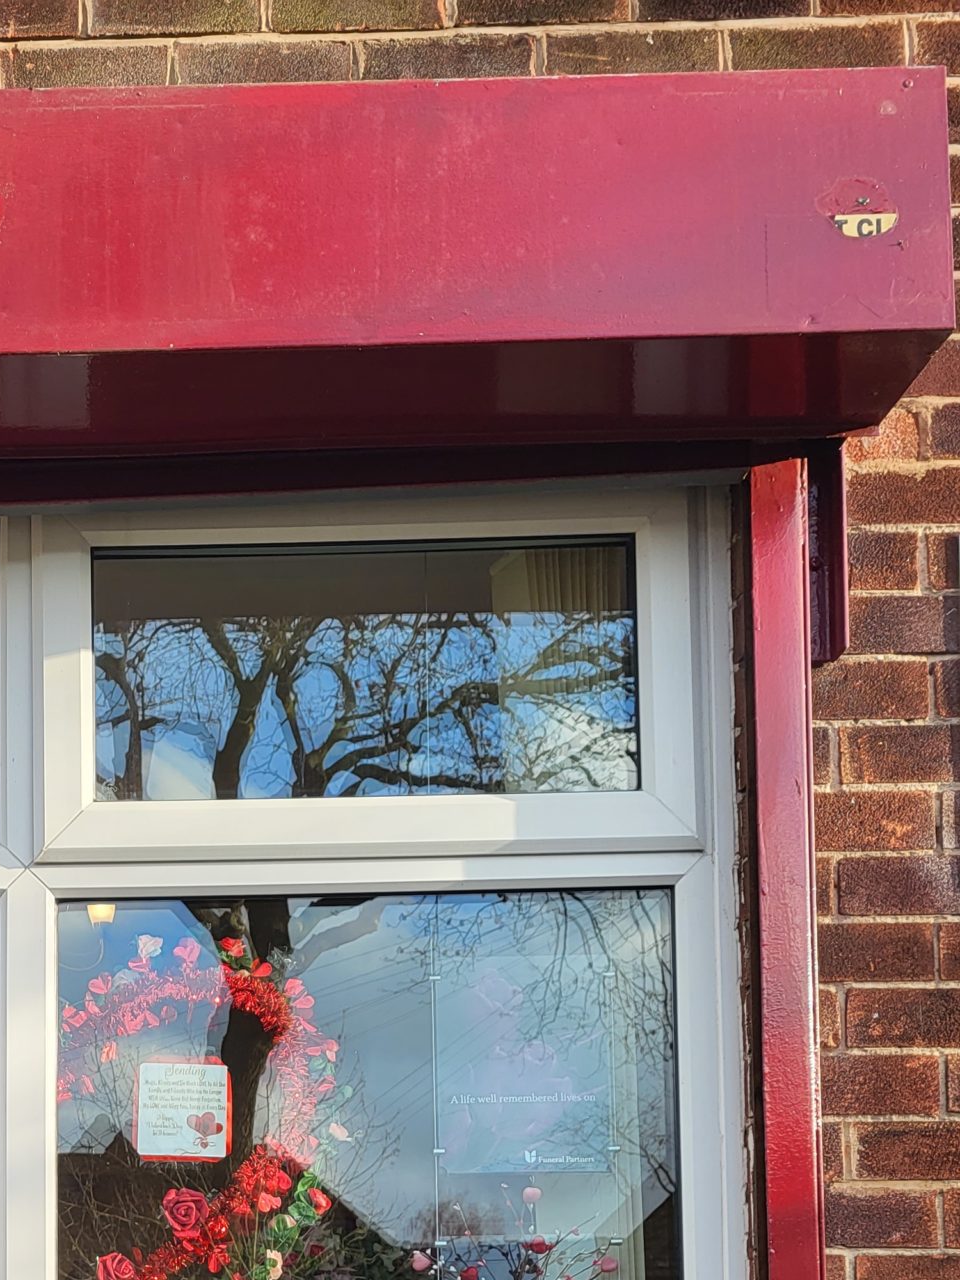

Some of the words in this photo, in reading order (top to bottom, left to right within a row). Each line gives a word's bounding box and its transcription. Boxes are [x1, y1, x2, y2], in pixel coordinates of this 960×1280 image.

[450, 1095, 459, 1104] A
[460, 1094, 476, 1104] life
[477, 1094, 497, 1104] well
[499, 1092, 558, 1103] remembered
[560, 1092, 582, 1102] lives
[538, 1156, 564, 1164] Funeral
